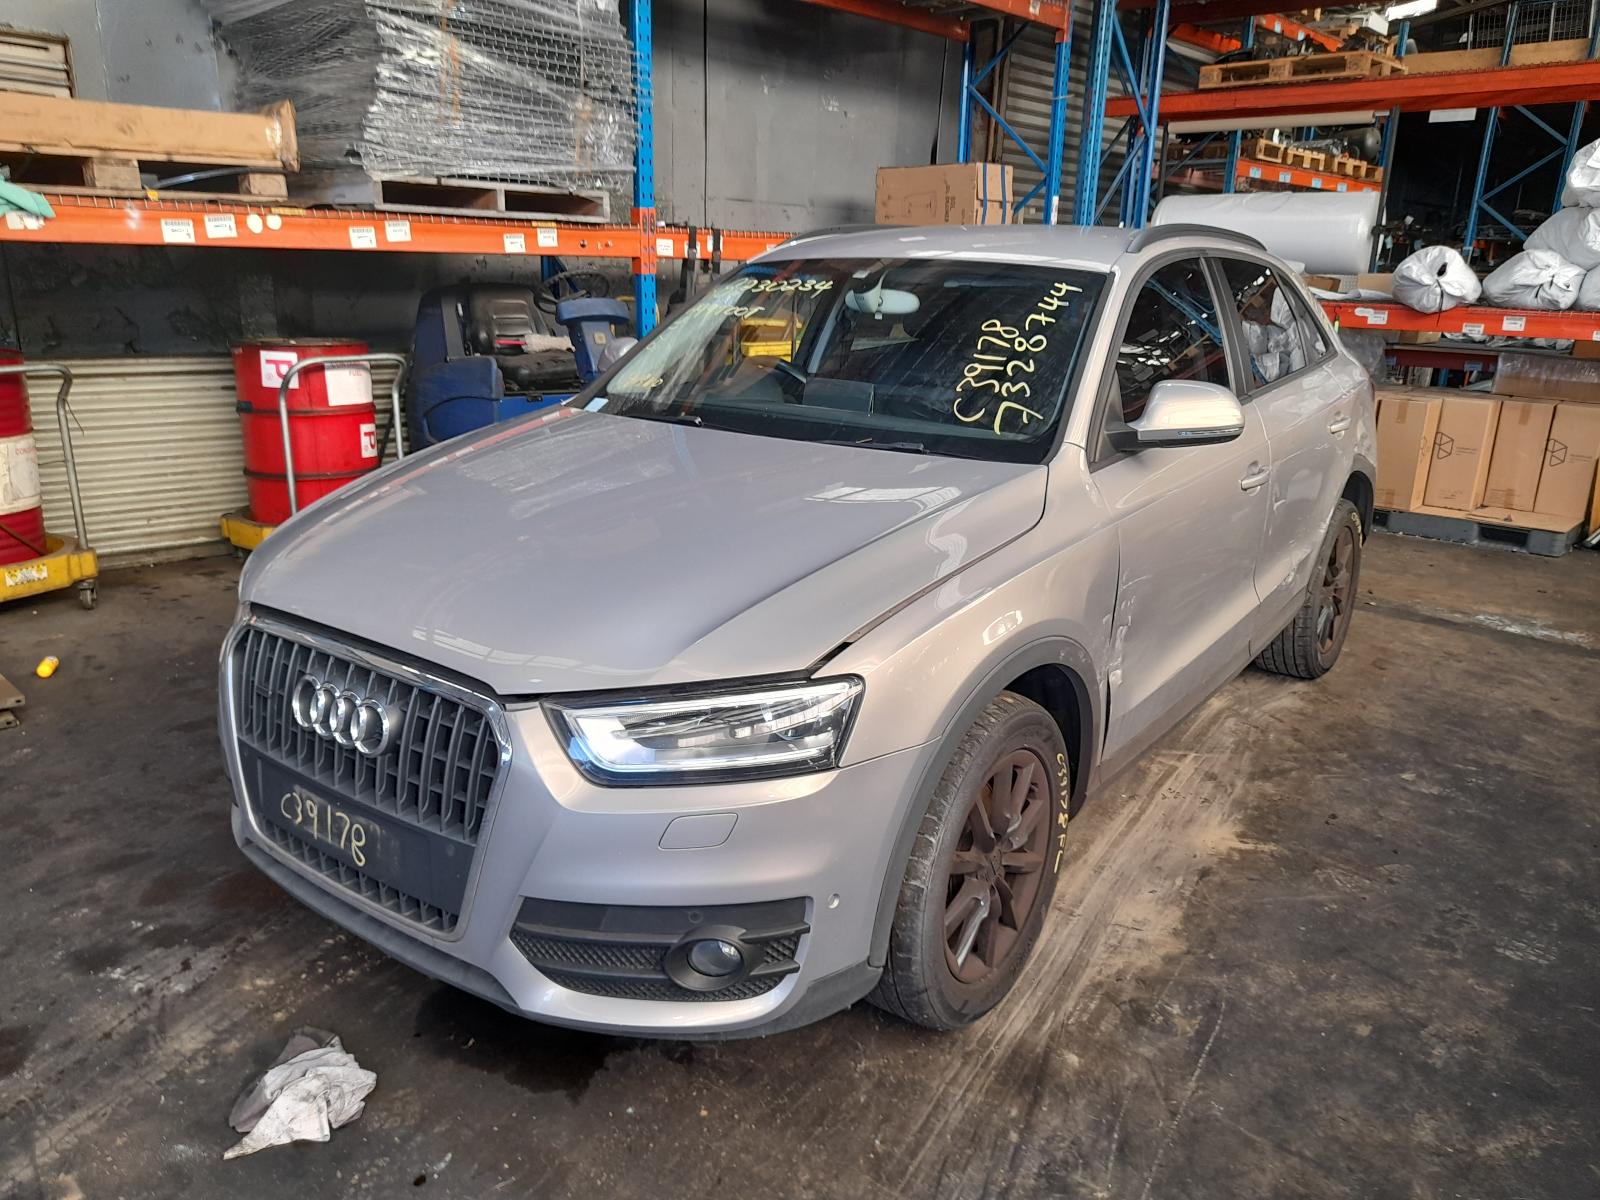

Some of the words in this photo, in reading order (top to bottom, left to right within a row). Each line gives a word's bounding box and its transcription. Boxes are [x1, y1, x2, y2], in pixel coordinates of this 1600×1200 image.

[953, 319, 1019, 423] C39178
[993, 282, 1083, 435] 7328744
[280, 791, 366, 867] C39178
